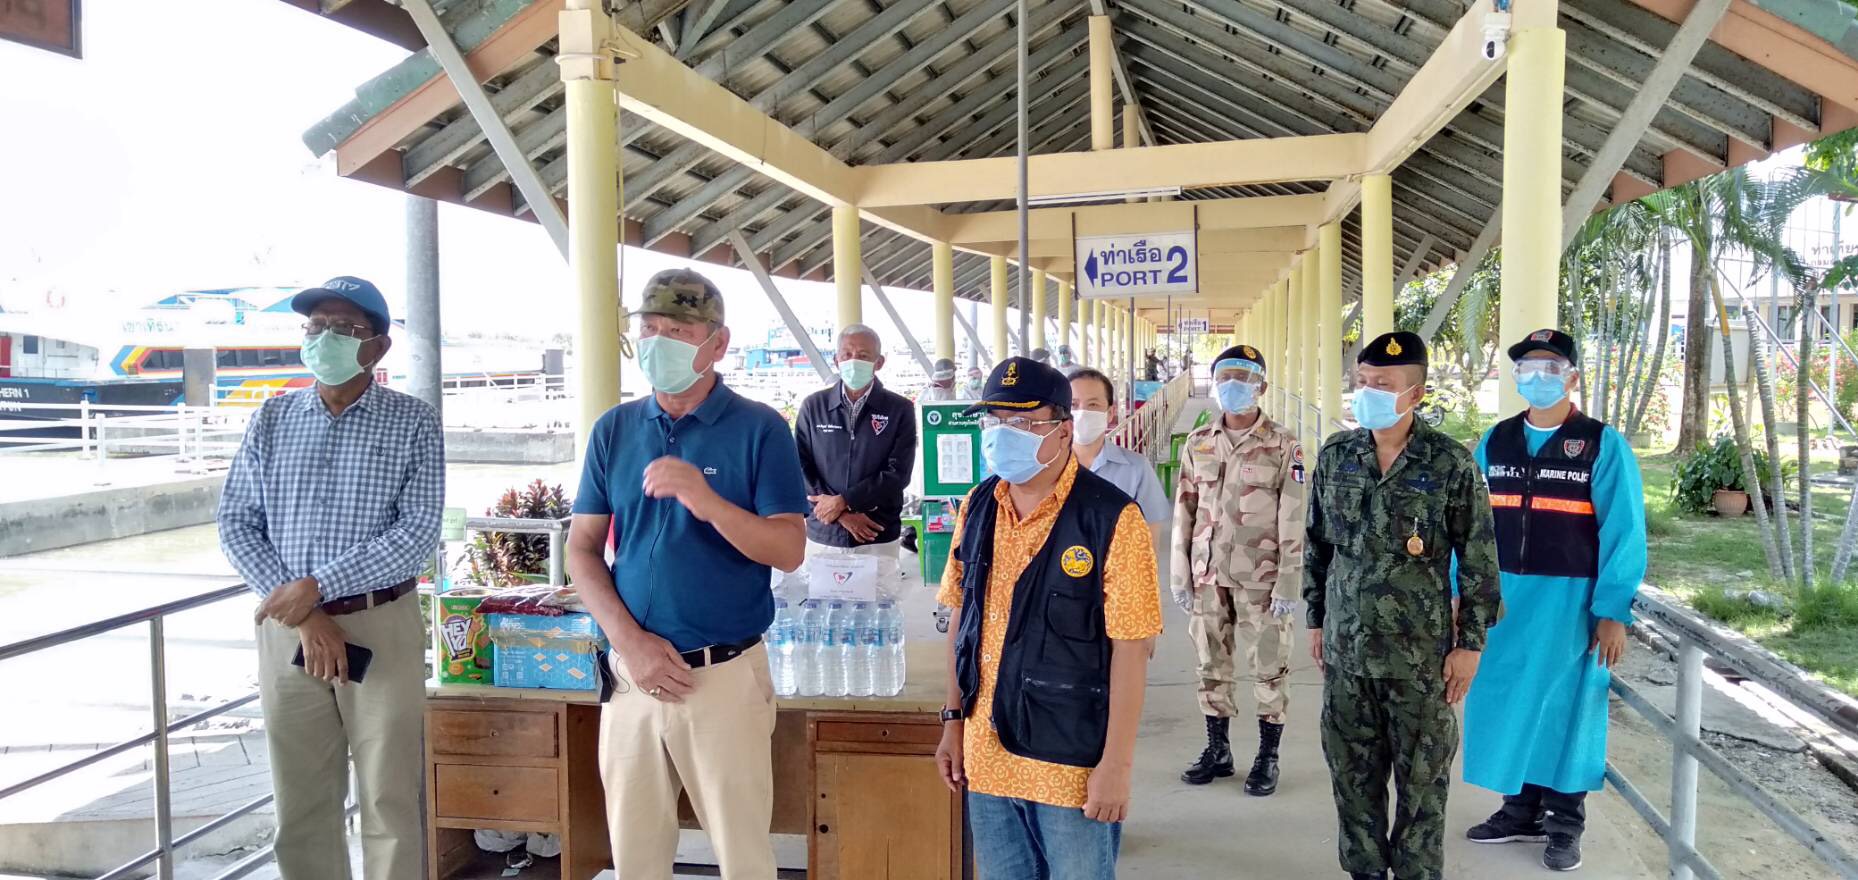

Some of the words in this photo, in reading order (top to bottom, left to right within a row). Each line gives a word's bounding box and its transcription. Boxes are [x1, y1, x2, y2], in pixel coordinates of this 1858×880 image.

[1100, 239, 1162, 266] ท่าเรือ
[1100, 269, 1162, 288] PORT
[1166, 245, 1188, 284] 2
[1202, 320, 1207, 331] 1
[23, 388, 30, 399] 1
[1539, 468, 1567, 480] MARINE
[1567, 470, 1590, 483] POLIC
